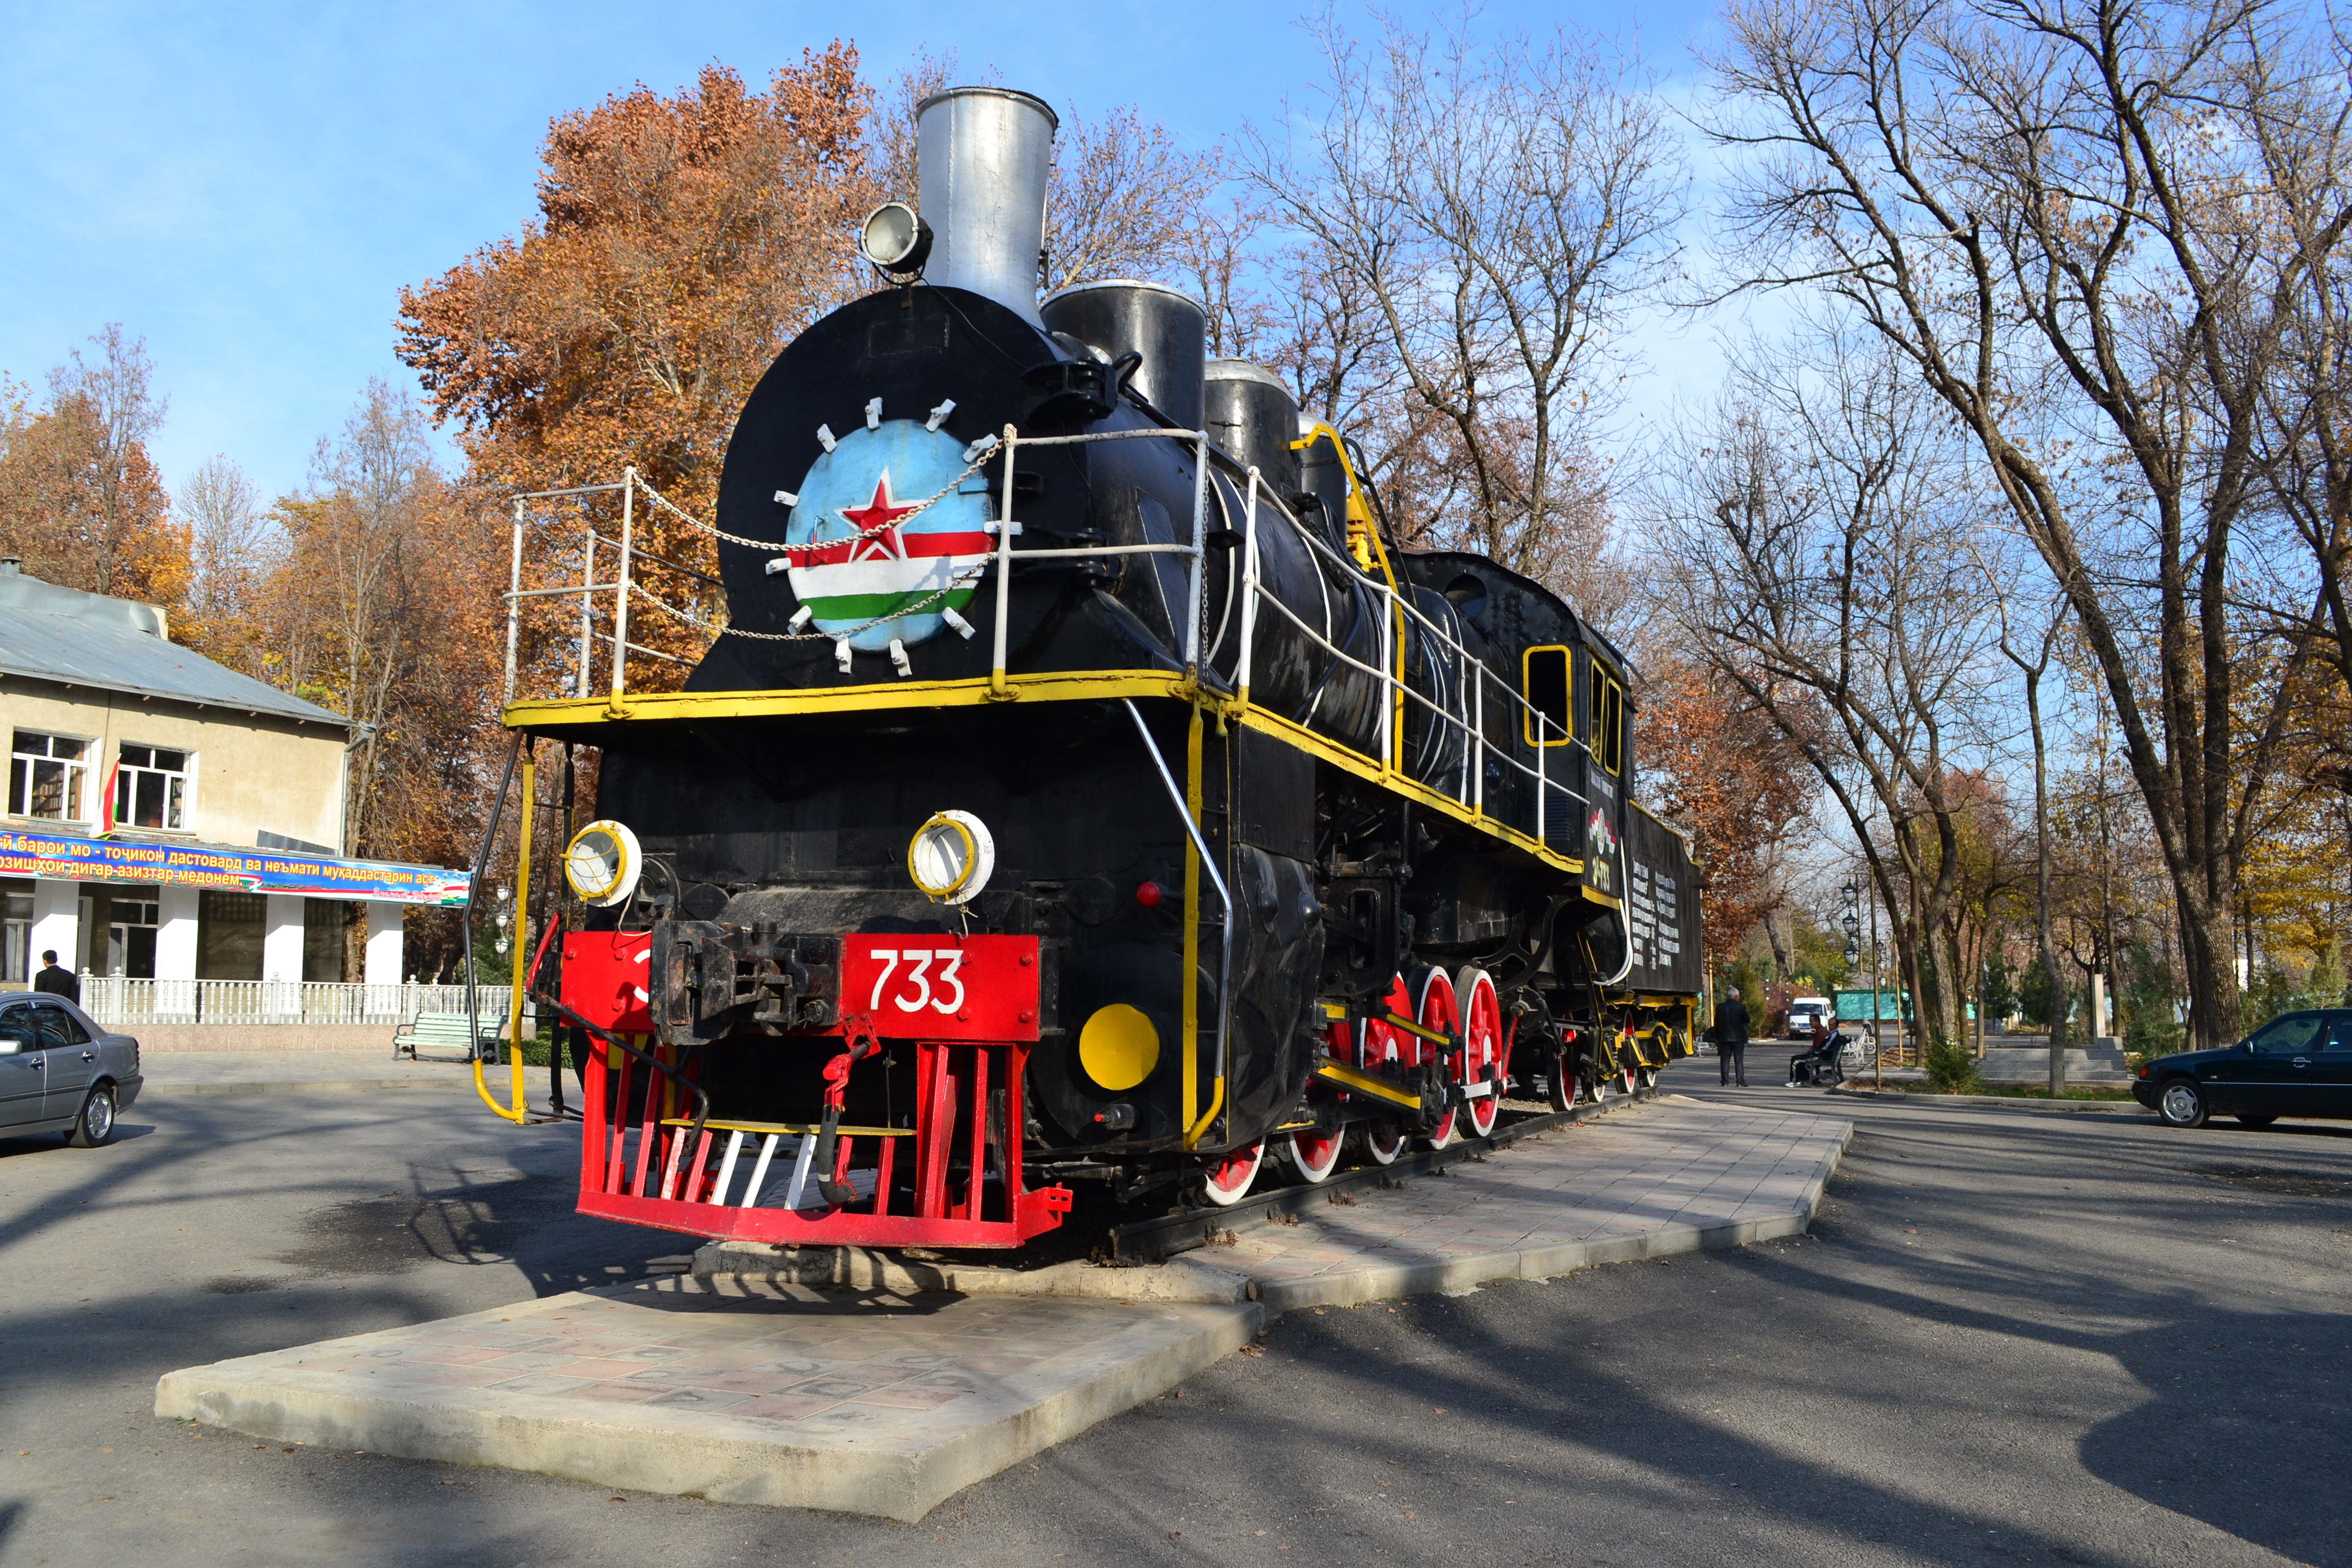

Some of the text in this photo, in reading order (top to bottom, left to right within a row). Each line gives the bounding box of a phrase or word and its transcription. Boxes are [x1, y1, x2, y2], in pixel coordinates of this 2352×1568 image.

[17, 835, 66, 856] барои
[70, 844, 91, 857] мо
[105, 847, 165, 863] тоҷикон
[168, 851, 242, 872] дастовард
[246, 859, 262, 871] ва
[264, 860, 320, 876] неъмати
[323, 865, 413, 885] муқаддастарин
[416, 873, 435, 885] аст
[68, 862, 113, 880] дигар
[117, 865, 174, 884] азизтар
[178, 869, 243, 886] медонем.
[870, 949, 965, 1014] 733
